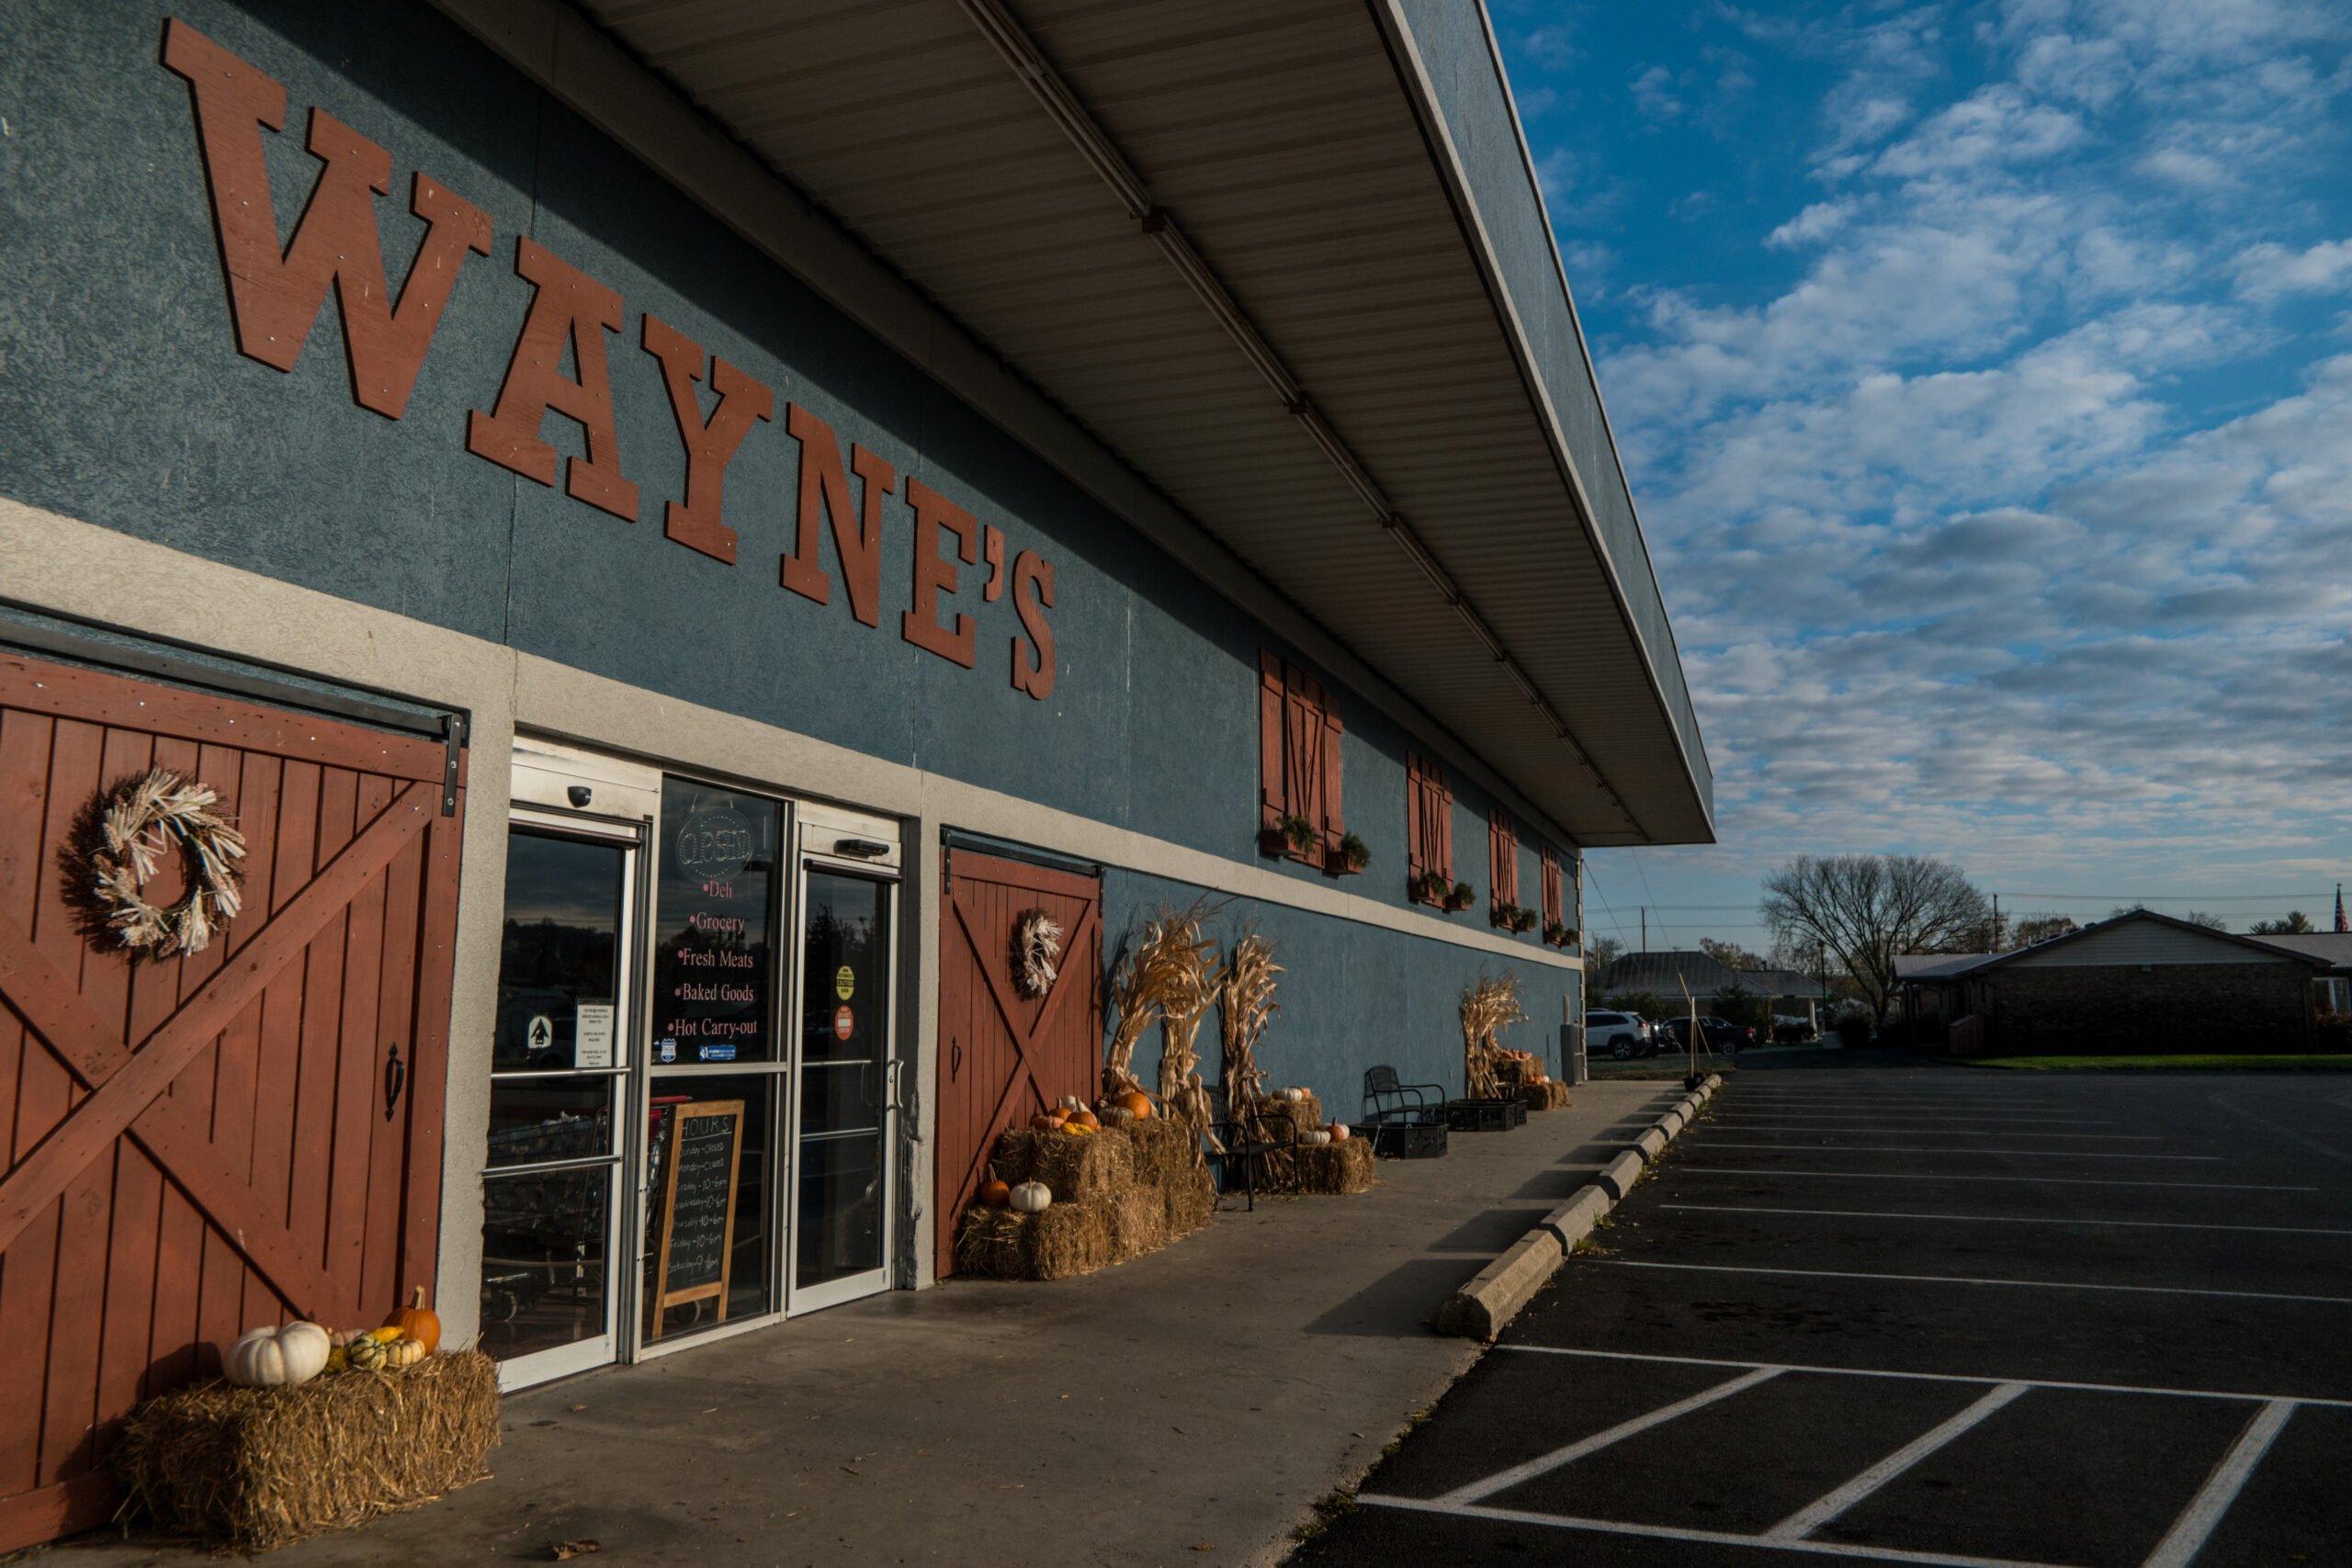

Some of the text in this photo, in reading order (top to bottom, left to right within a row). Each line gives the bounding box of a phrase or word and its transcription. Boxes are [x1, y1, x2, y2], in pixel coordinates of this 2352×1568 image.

[159, 17, 1056, 700] WAYNE'S
[709, 880, 732, 898] Deli
[696, 911, 745, 935] Grocery
[683, 948, 753, 968] Fresh Meats
[683, 983, 754, 1001] Baked Goods
[674, 1018, 757, 1040] Hot Carry-out
[683, 1115, 729, 1136] HOURS
